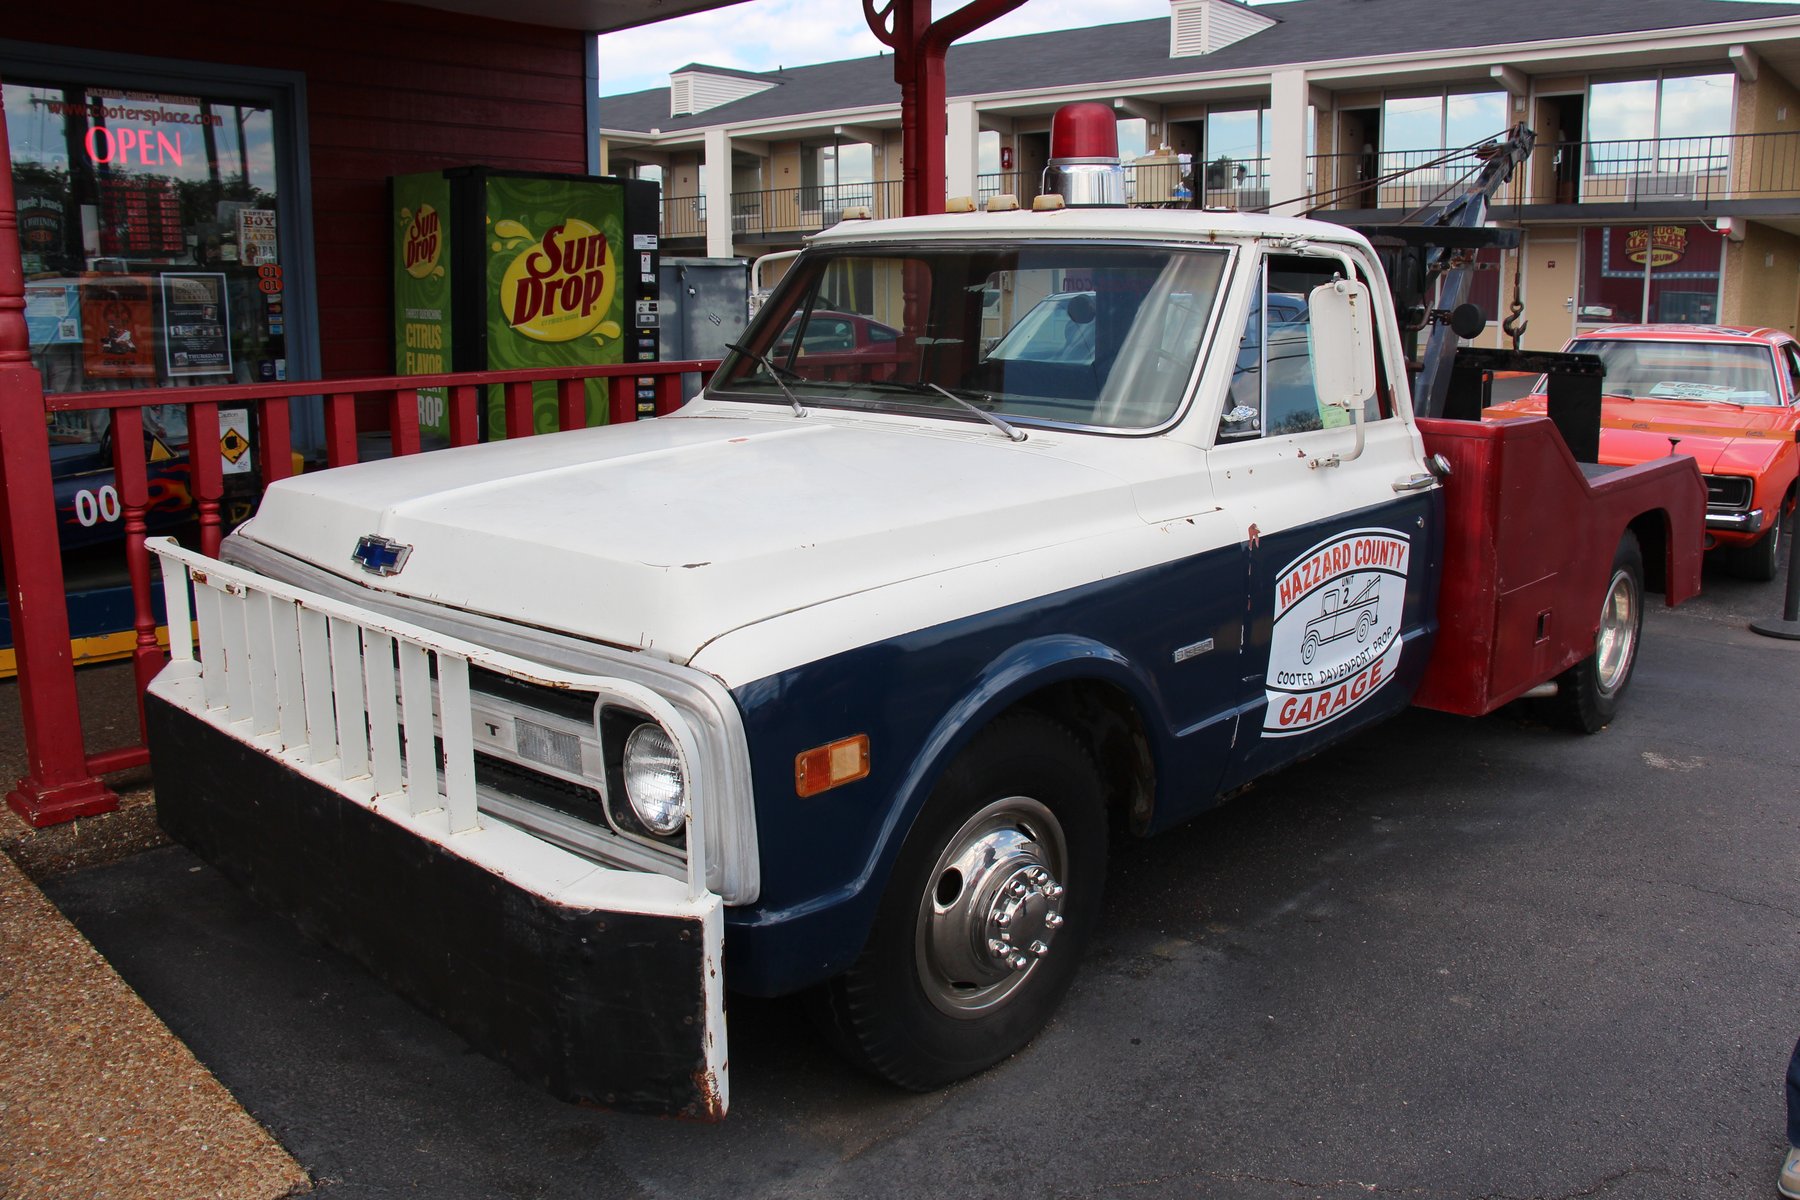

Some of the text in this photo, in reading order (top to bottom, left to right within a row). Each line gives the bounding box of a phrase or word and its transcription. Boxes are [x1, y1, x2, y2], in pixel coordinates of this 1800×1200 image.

[49, 102, 223, 127] www.cootersplace.com
[85, 126, 183, 167] OPEN
[243, 216, 275, 226] BOY
[244, 233, 275, 241] LAND
[410, 207, 438, 242] Sun
[405, 233, 437, 270] Drop
[525, 224, 608, 280] Sun
[263, 266, 277, 278] 01
[264, 280, 278, 291] 01
[510, 269, 605, 328] Drop
[406, 323, 442, 350] CITRUS
[406, 352, 442, 375] FLAVOR
[417, 395, 443, 428] ROP
[75, 485, 121, 527] 00
[1279, 539, 1406, 609] HAZZARD COUNTY
[1341, 575, 1355, 588] UNIT
[1342, 588, 1350, 605] 2
[1277, 626, 1393, 686] COOTER DAVENPORT, PROP.
[1278, 658, 1385, 727] GARAGE
